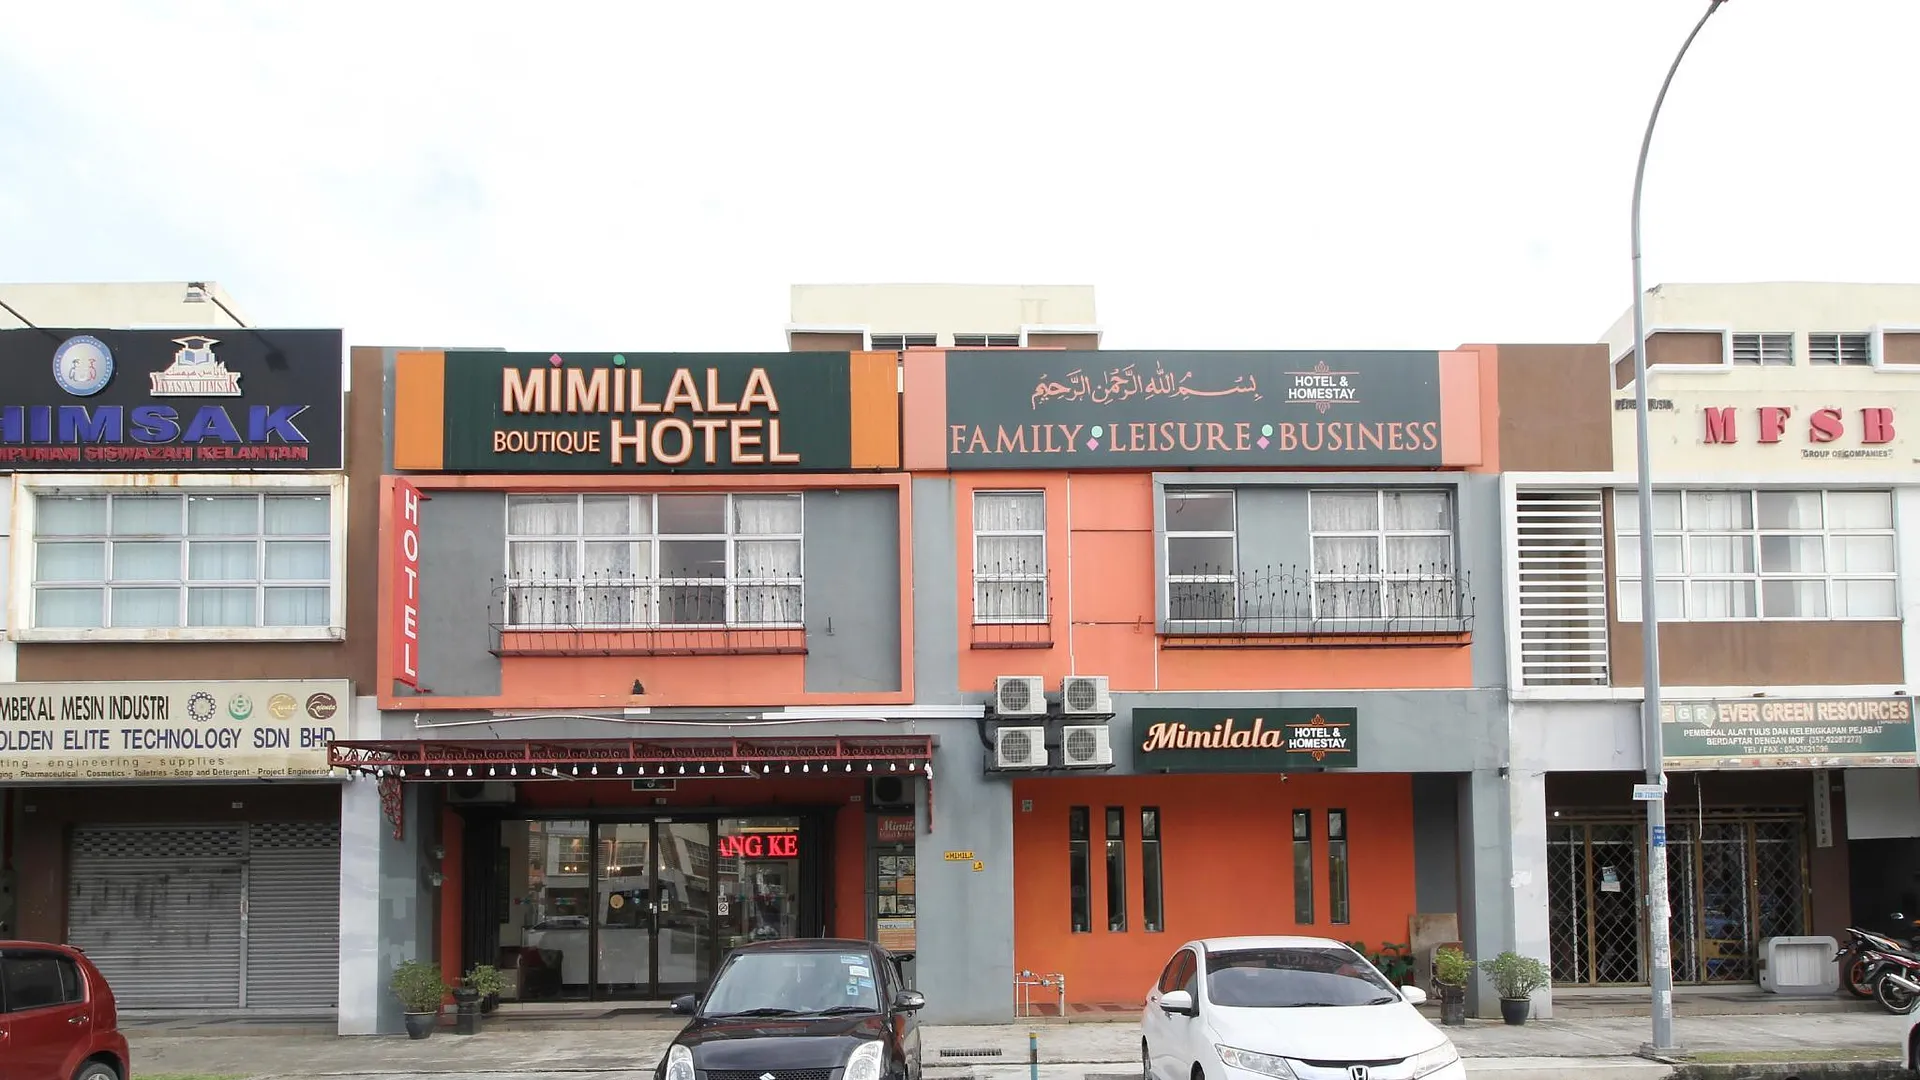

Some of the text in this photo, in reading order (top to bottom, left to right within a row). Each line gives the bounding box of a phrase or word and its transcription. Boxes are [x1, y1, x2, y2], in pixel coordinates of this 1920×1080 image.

[1295, 375, 1349, 387] HOTEL &
[1288, 388, 1356, 399] HOMESTAY
[493, 417, 801, 464] BOUTIQUE HOTEL
[949, 422, 1437, 454] FAMILY LEISURE BUSINESS
[84, 446, 193, 462] SISWAZAH
[196, 445, 309, 462] KELANTAN
[402, 488, 419, 678] HOTEL
[61, 695, 104, 721] MESIN
[109, 695, 169, 721] INDUSTRI
[1718, 700, 1909, 722] EVER GREEN RESOURCES
[1142, 718, 1285, 752] Mimilala
[1294, 727, 1341, 738] HOTEL &
[1683, 728, 1727, 737] PEMBEKAL
[1727, 728, 1748, 736] ALAT
[1748, 727, 1771, 736] TULIS
[1772, 727, 1789, 736] DAN
[1848, 725, 1883, 734] PEJABAT
[63, 729, 110, 750] ELITE
[121, 728, 242, 750] TECHNOLOGY
[253, 727, 290, 749] SDN
[300, 727, 336, 748] BHD
[1288, 738, 1347, 749] HOMESTAY
[1706, 737, 1753, 746] BERDAFTAR
[1754, 737, 1788, 745] DENGAN
[1743, 746, 1758, 754] TEL
[47, 758, 140, 769] engineering
[160, 757, 225, 767] supplies
[20, 769, 78, 778] Pharmaceutical
[86, 769, 125, 777] Cosmetics
[134, 769, 168, 777] Toiletries
[174, 768, 193, 777] Soap
[196, 768, 210, 776] and
[212, 768, 250, 777] Detergent
[258, 767, 285, 777] Project
[287, 767, 330, 777] Engineering
[767, 835, 798, 857] KE
